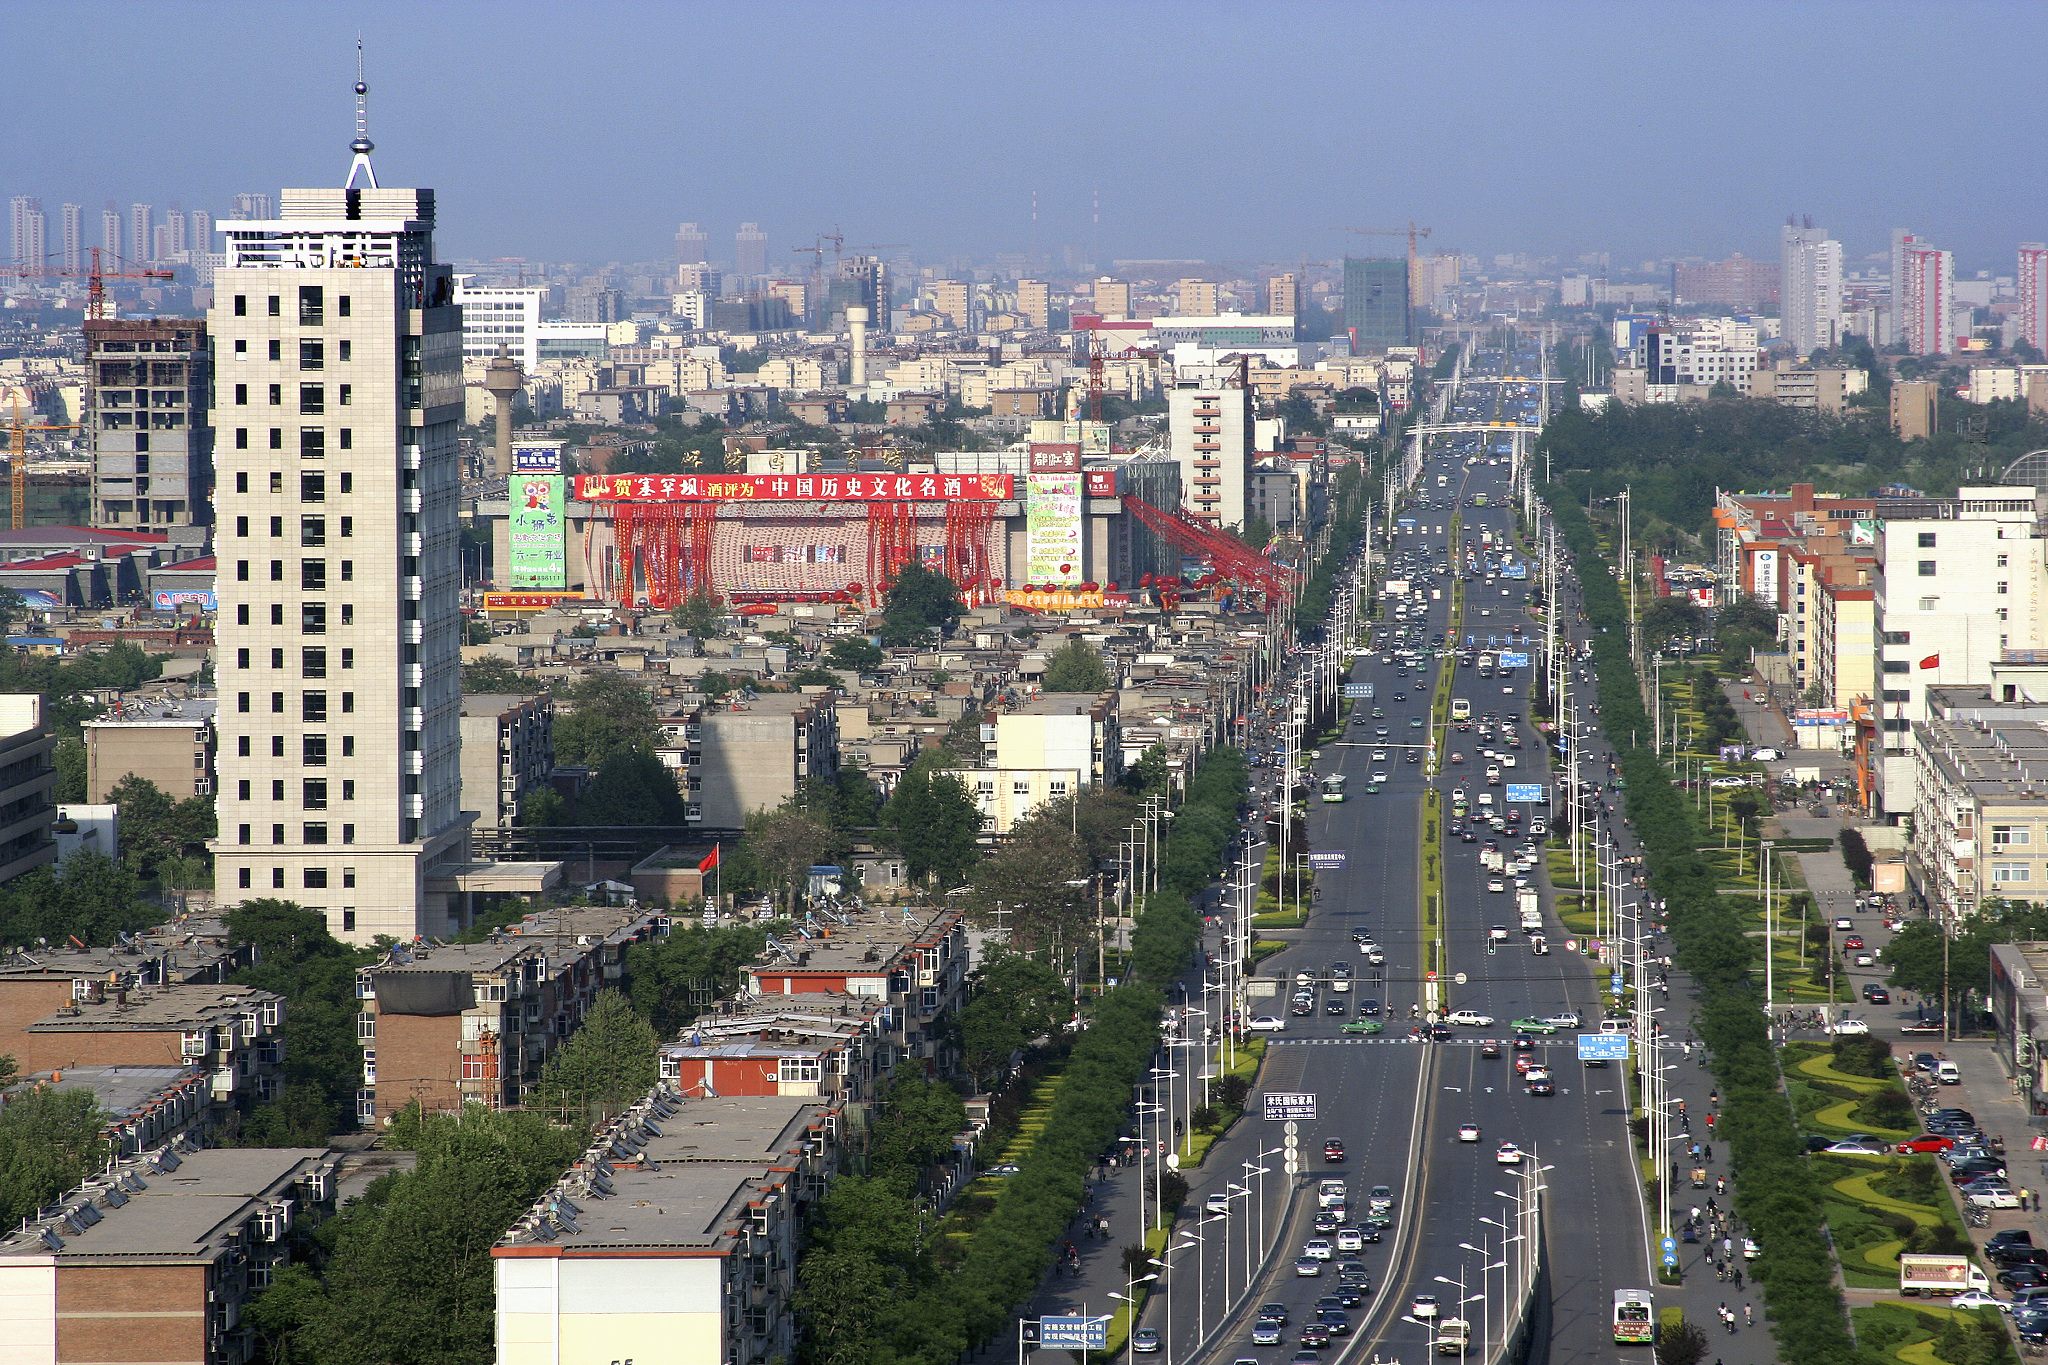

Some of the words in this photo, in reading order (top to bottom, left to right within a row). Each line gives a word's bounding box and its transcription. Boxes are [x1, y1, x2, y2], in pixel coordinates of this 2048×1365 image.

[1267, 1096, 1314, 1106] 米氏国际家具
